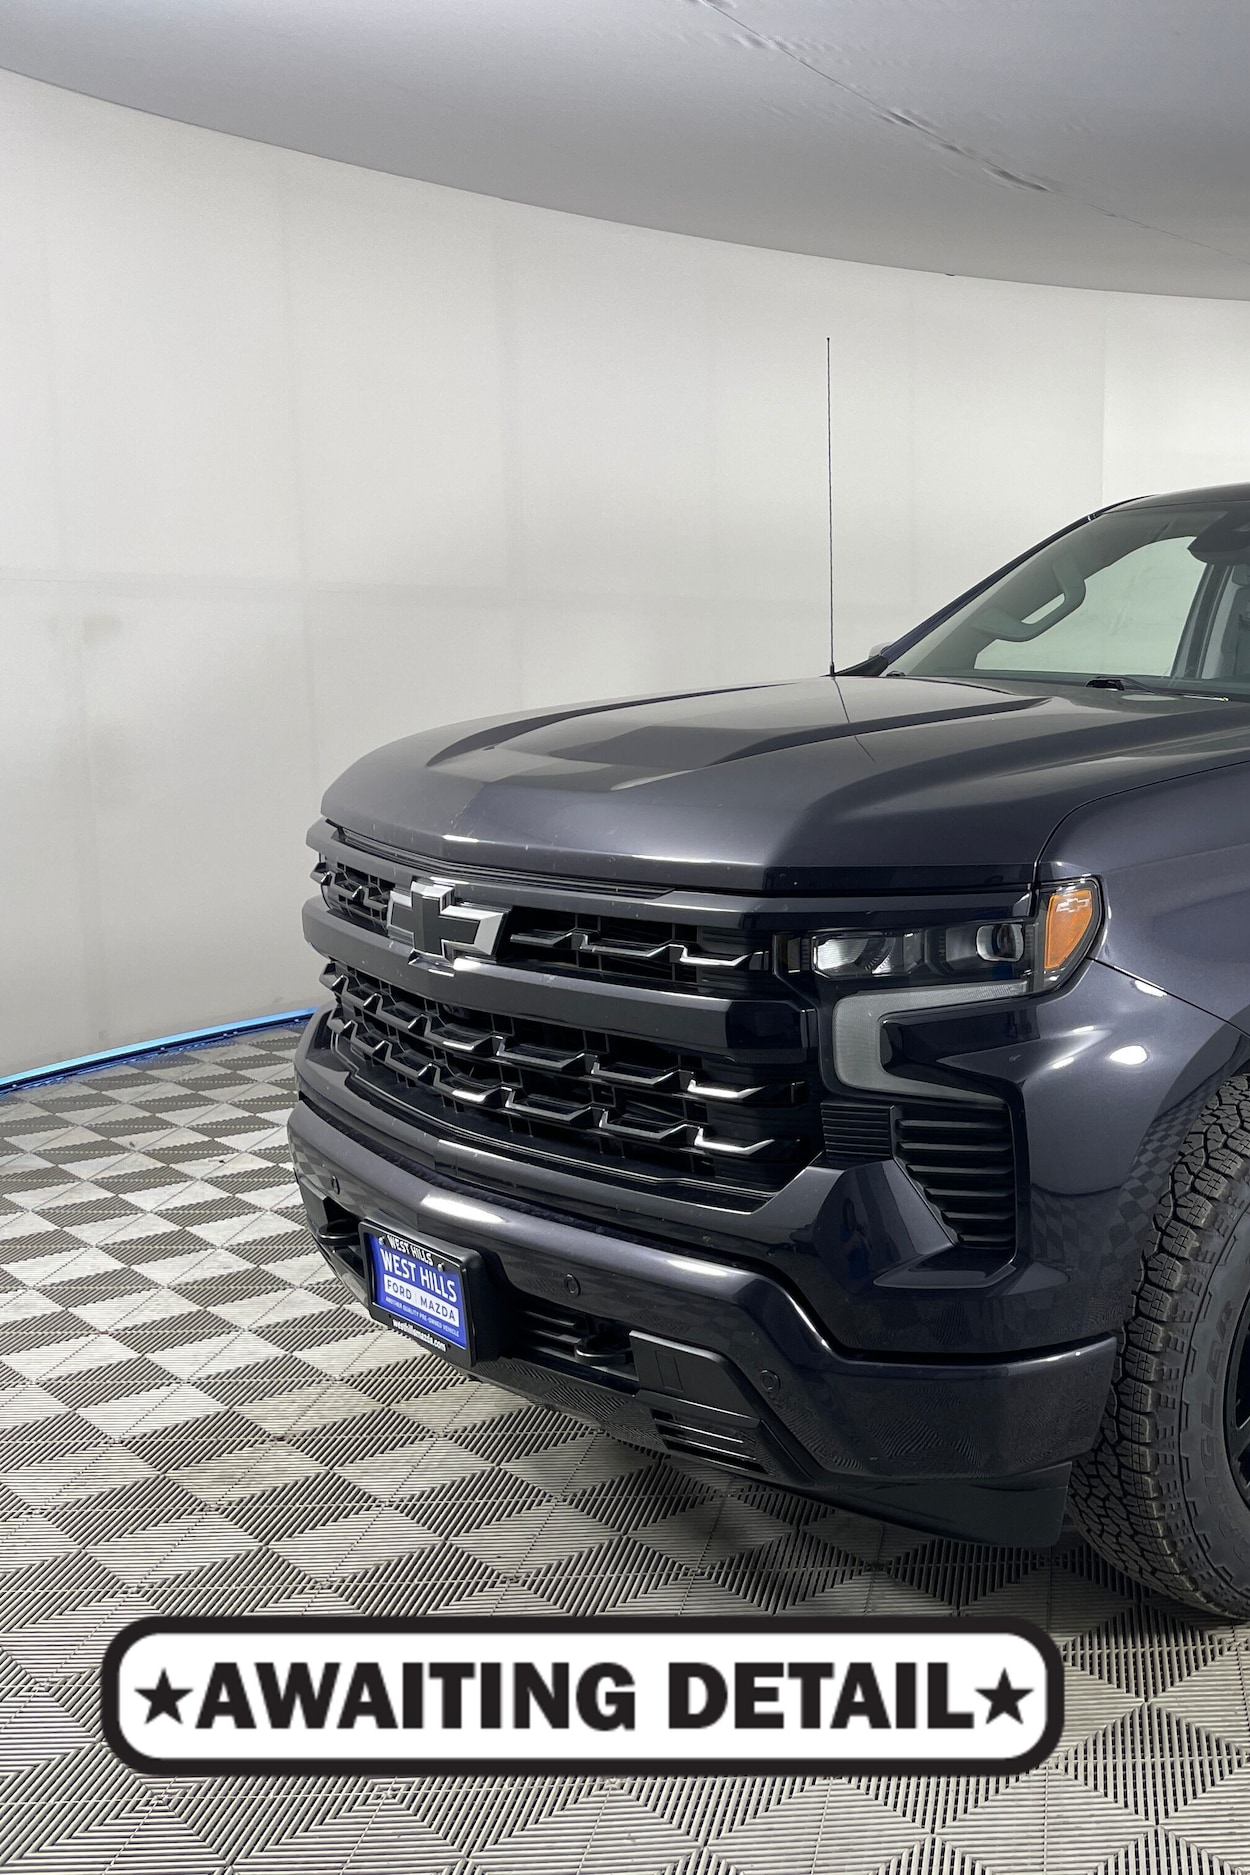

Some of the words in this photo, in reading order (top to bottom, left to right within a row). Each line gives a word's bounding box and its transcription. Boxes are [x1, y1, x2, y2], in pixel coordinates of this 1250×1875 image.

[387, 1234, 410, 1257] WEST
[410, 1243, 434, 1267] HILLS
[380, 1248, 416, 1282] WEST
[420, 1266, 457, 1303] HILLS
[387, 1279, 412, 1300] FORD
[420, 1296, 456, 1322] MAZDA
[392, 1319, 447, 1352] westhillsmazda.com
[443, 1323, 460, 1338] VEHICLE
